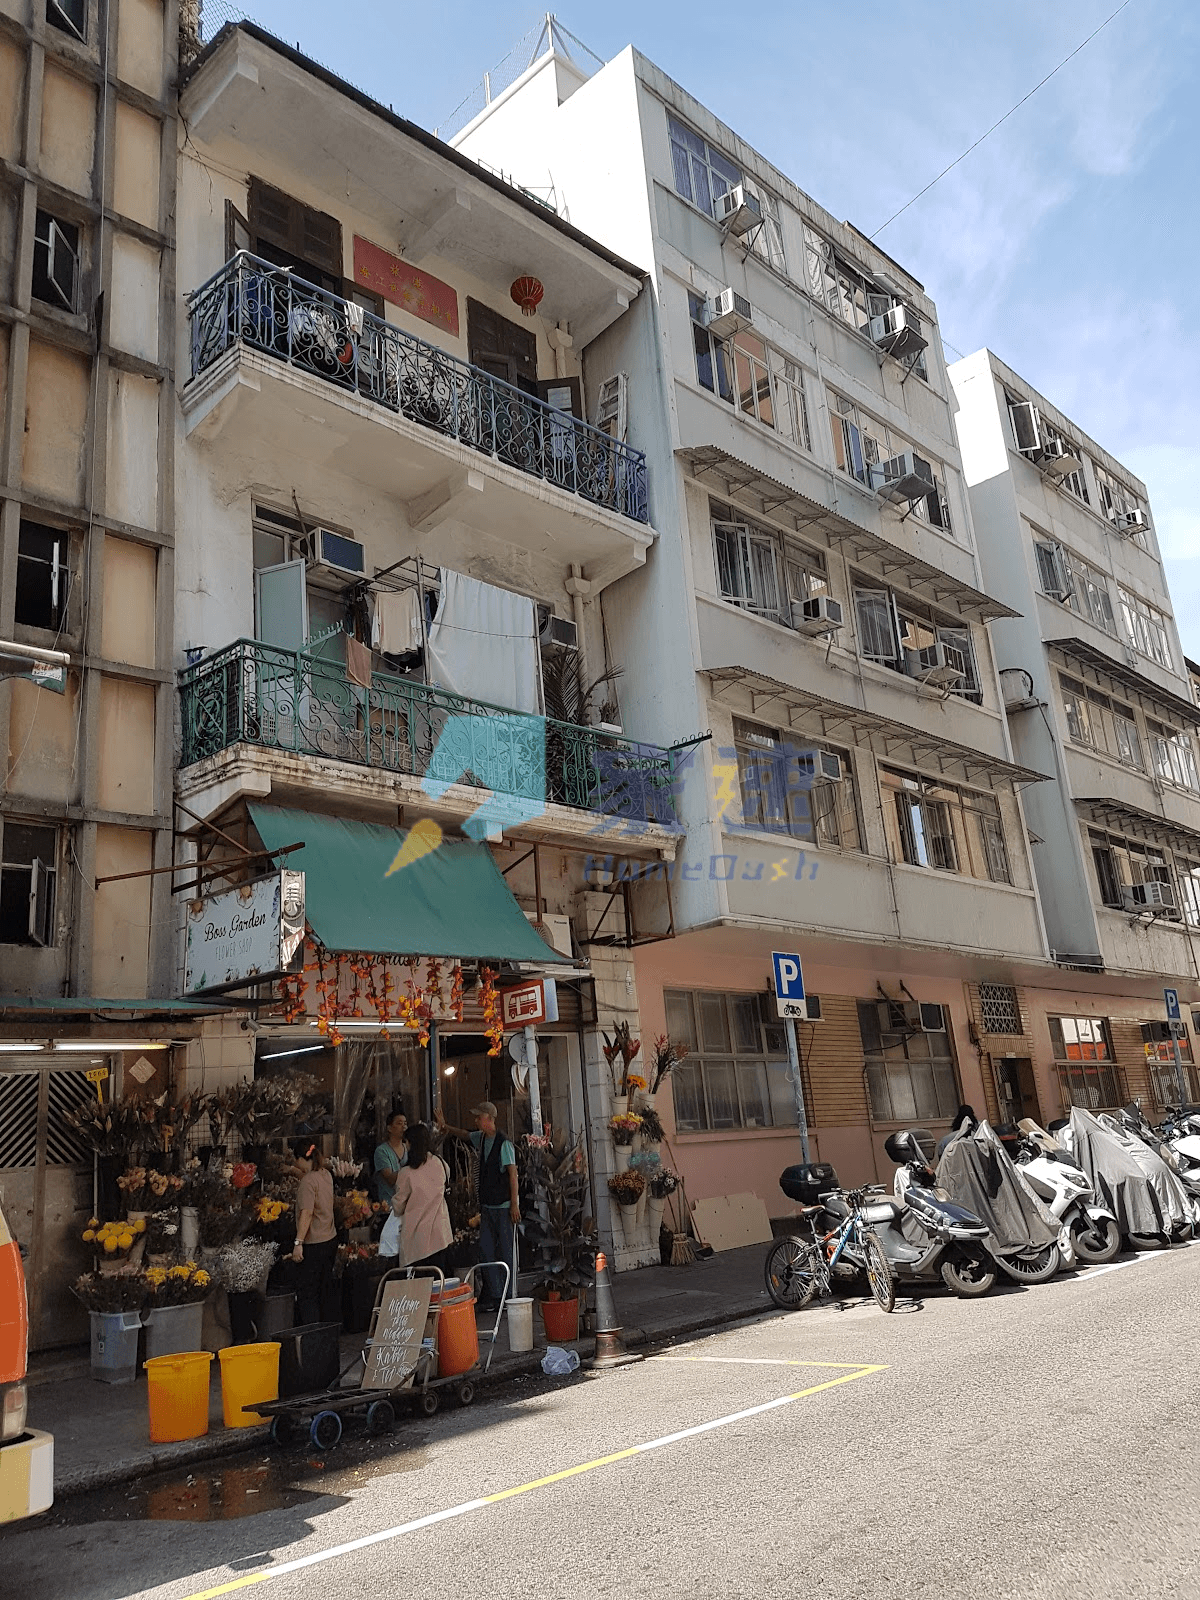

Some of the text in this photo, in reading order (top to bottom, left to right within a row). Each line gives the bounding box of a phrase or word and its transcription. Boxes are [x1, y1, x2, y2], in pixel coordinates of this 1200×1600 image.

[204, 908, 267, 942] Boss Garden
[215, 940, 237, 961] FLOWER
[778, 958, 799, 995] P
[1166, 992, 1177, 1016] P
[388, 1295, 421, 1318] Welcome
